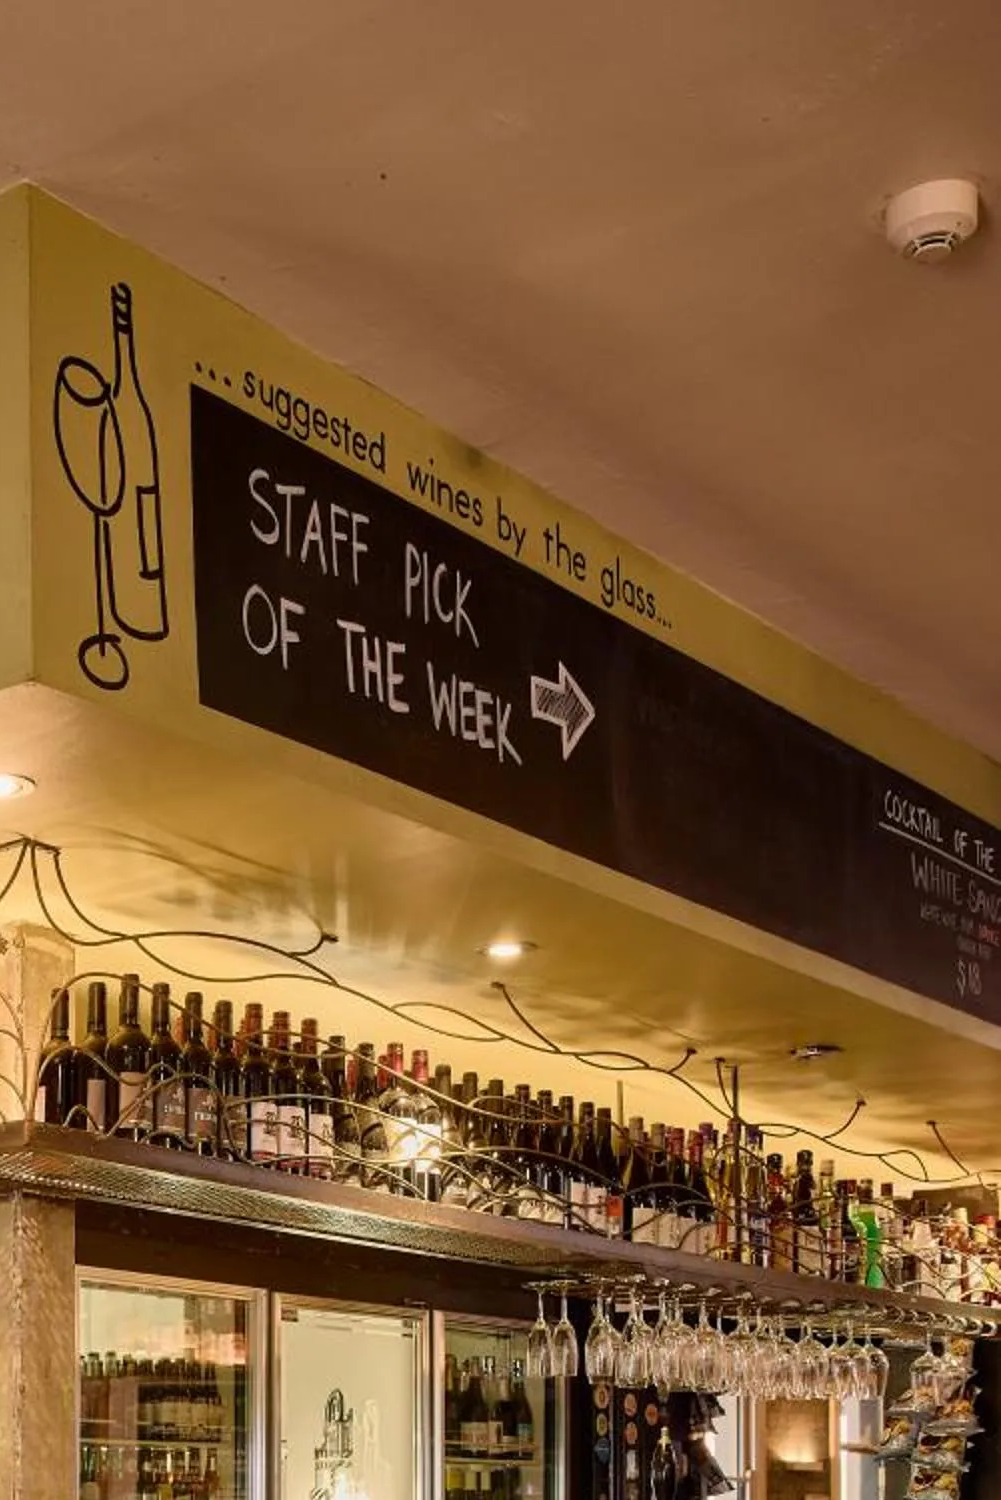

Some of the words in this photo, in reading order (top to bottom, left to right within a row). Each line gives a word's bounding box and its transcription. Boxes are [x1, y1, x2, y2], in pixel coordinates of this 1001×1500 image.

[249, 468, 371, 585] STAFF
[404, 542, 480, 648] PICK
[407, 457, 484, 528] wines
[497, 496, 527, 556] by
[542, 526, 587, 583] the
[242, 584, 305, 670] OF
[336, 618, 410, 714] THE
[426, 660, 523, 767] WEEK
[884, 789, 943, 843] COCKTAIL
[954, 828, 968, 858] OF
[974, 838, 995, 873] THE
[910, 851, 963, 906] WHITE
